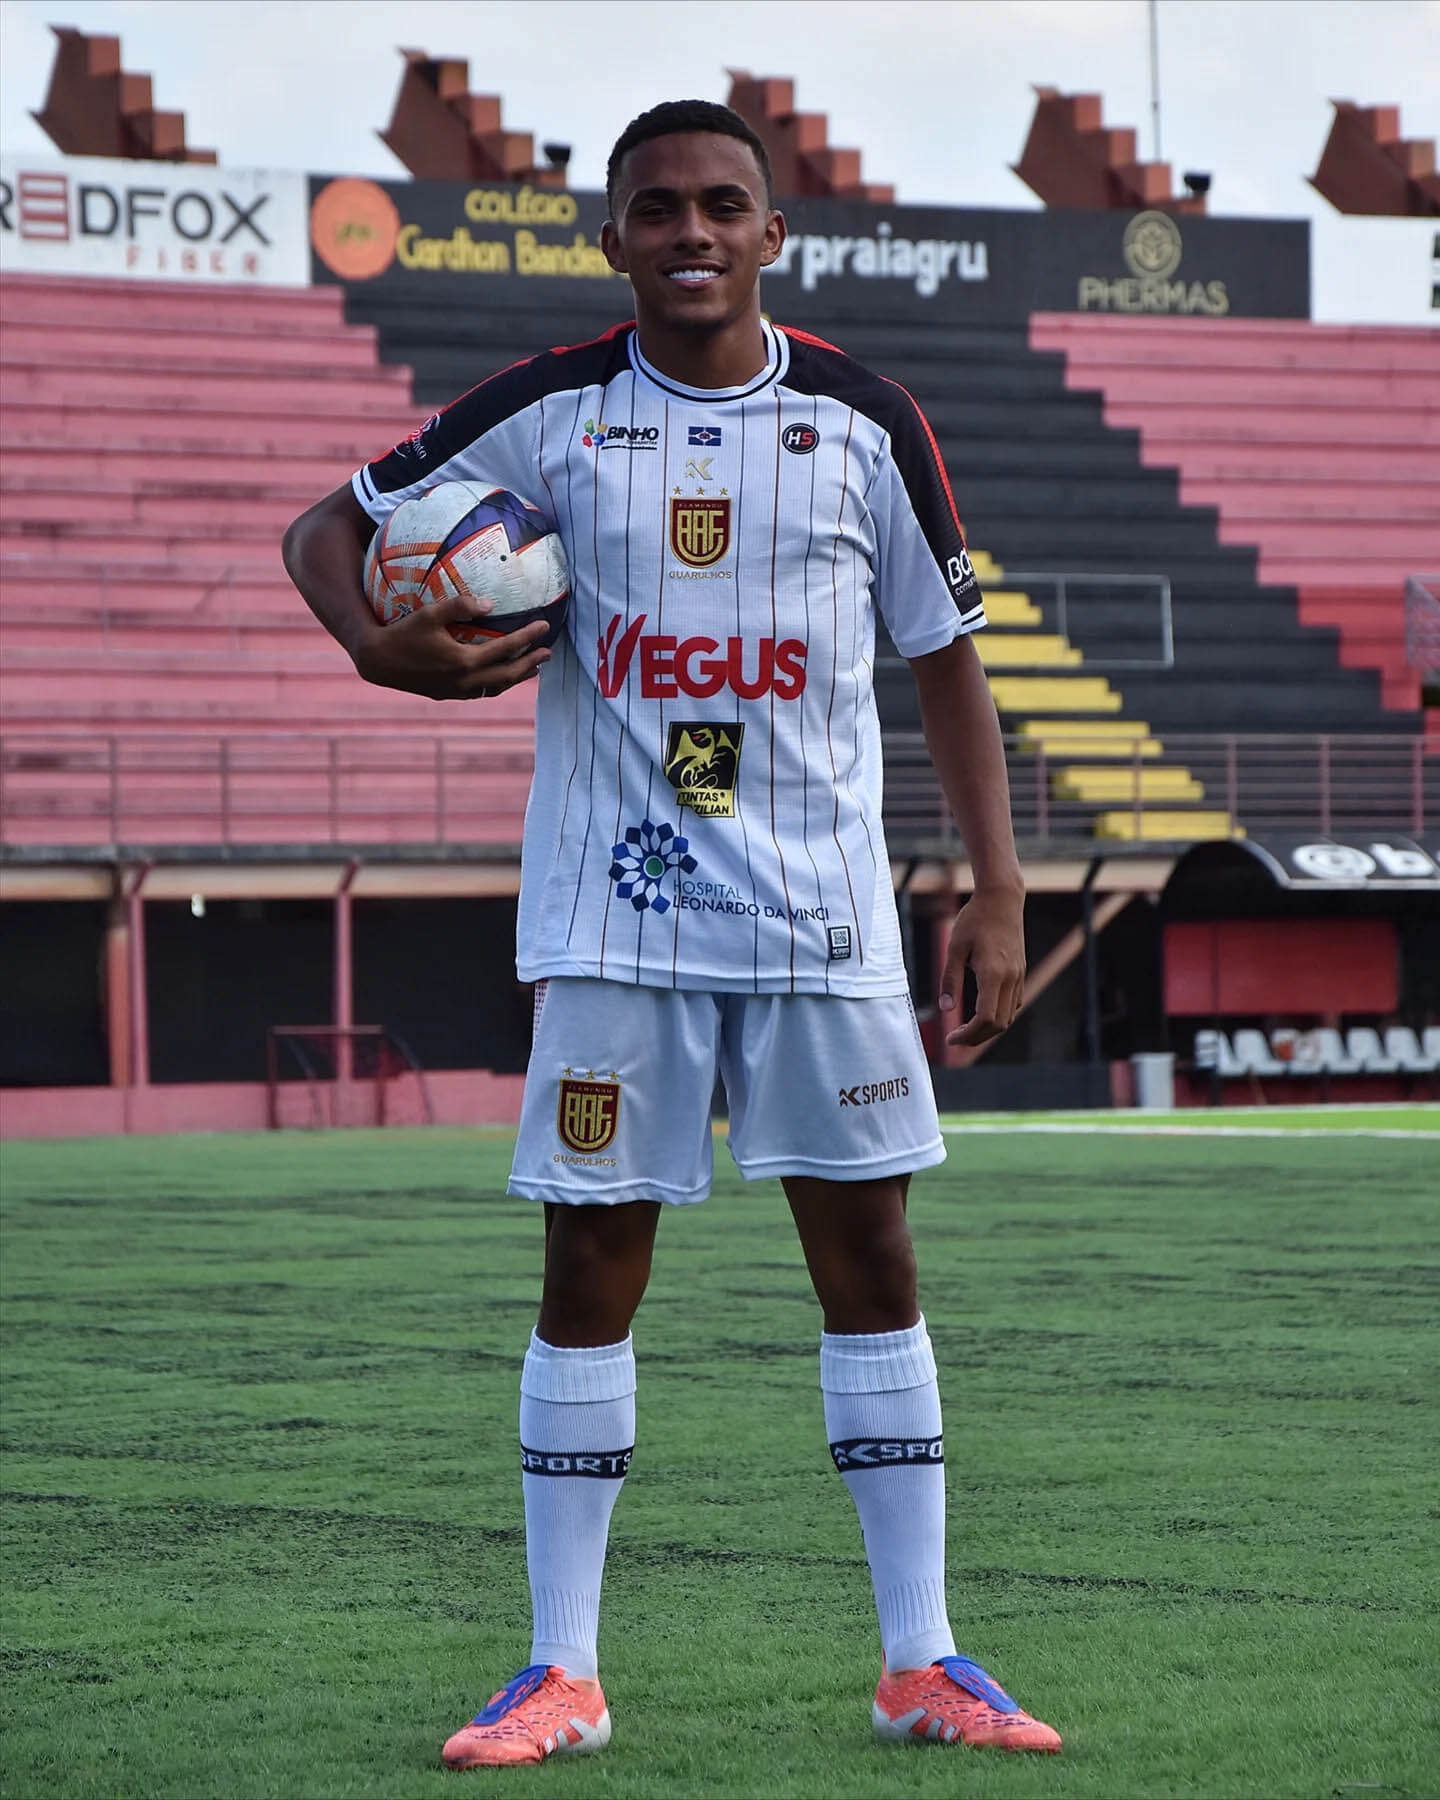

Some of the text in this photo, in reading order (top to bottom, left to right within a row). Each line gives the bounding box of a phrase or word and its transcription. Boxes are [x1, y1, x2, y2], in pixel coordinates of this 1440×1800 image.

[760, 221, 988, 297] rpraiagru
[607, 427, 659, 441] BINHO
[787, 431, 814, 446] HS
[669, 570, 733, 580] GUARULHOS
[694, 804, 729, 815] ZILIAN
[673, 879, 743, 900] HOSPITAL
[673, 895, 830, 921] LEONARDO DA VINCI
